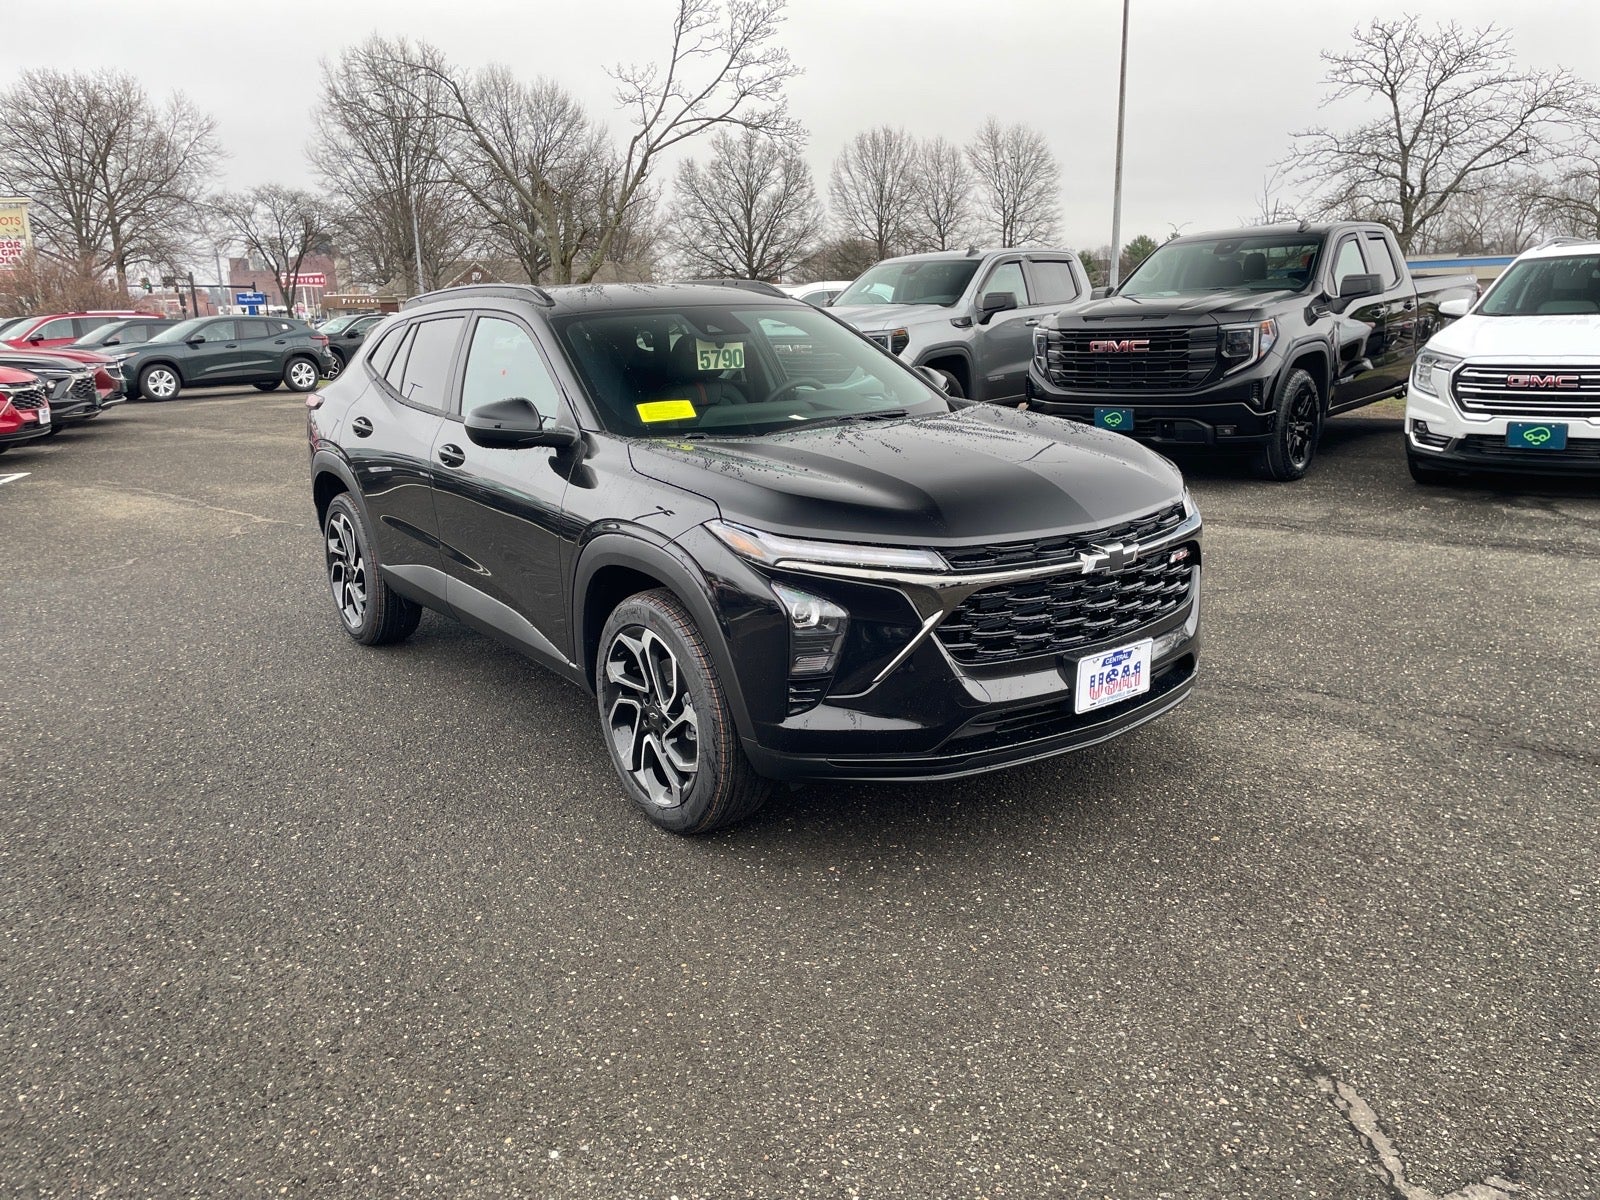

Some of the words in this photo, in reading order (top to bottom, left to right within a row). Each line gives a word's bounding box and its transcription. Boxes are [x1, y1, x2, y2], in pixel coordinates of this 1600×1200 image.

[0, 217, 21, 226] OTS
[280, 275, 324, 285] Frstone
[1089, 339, 1150, 353] GMC
[699, 348, 743, 369] 5790
[1507, 374, 1579, 388] GMC
[1105, 653, 1129, 665] CENTRAL
